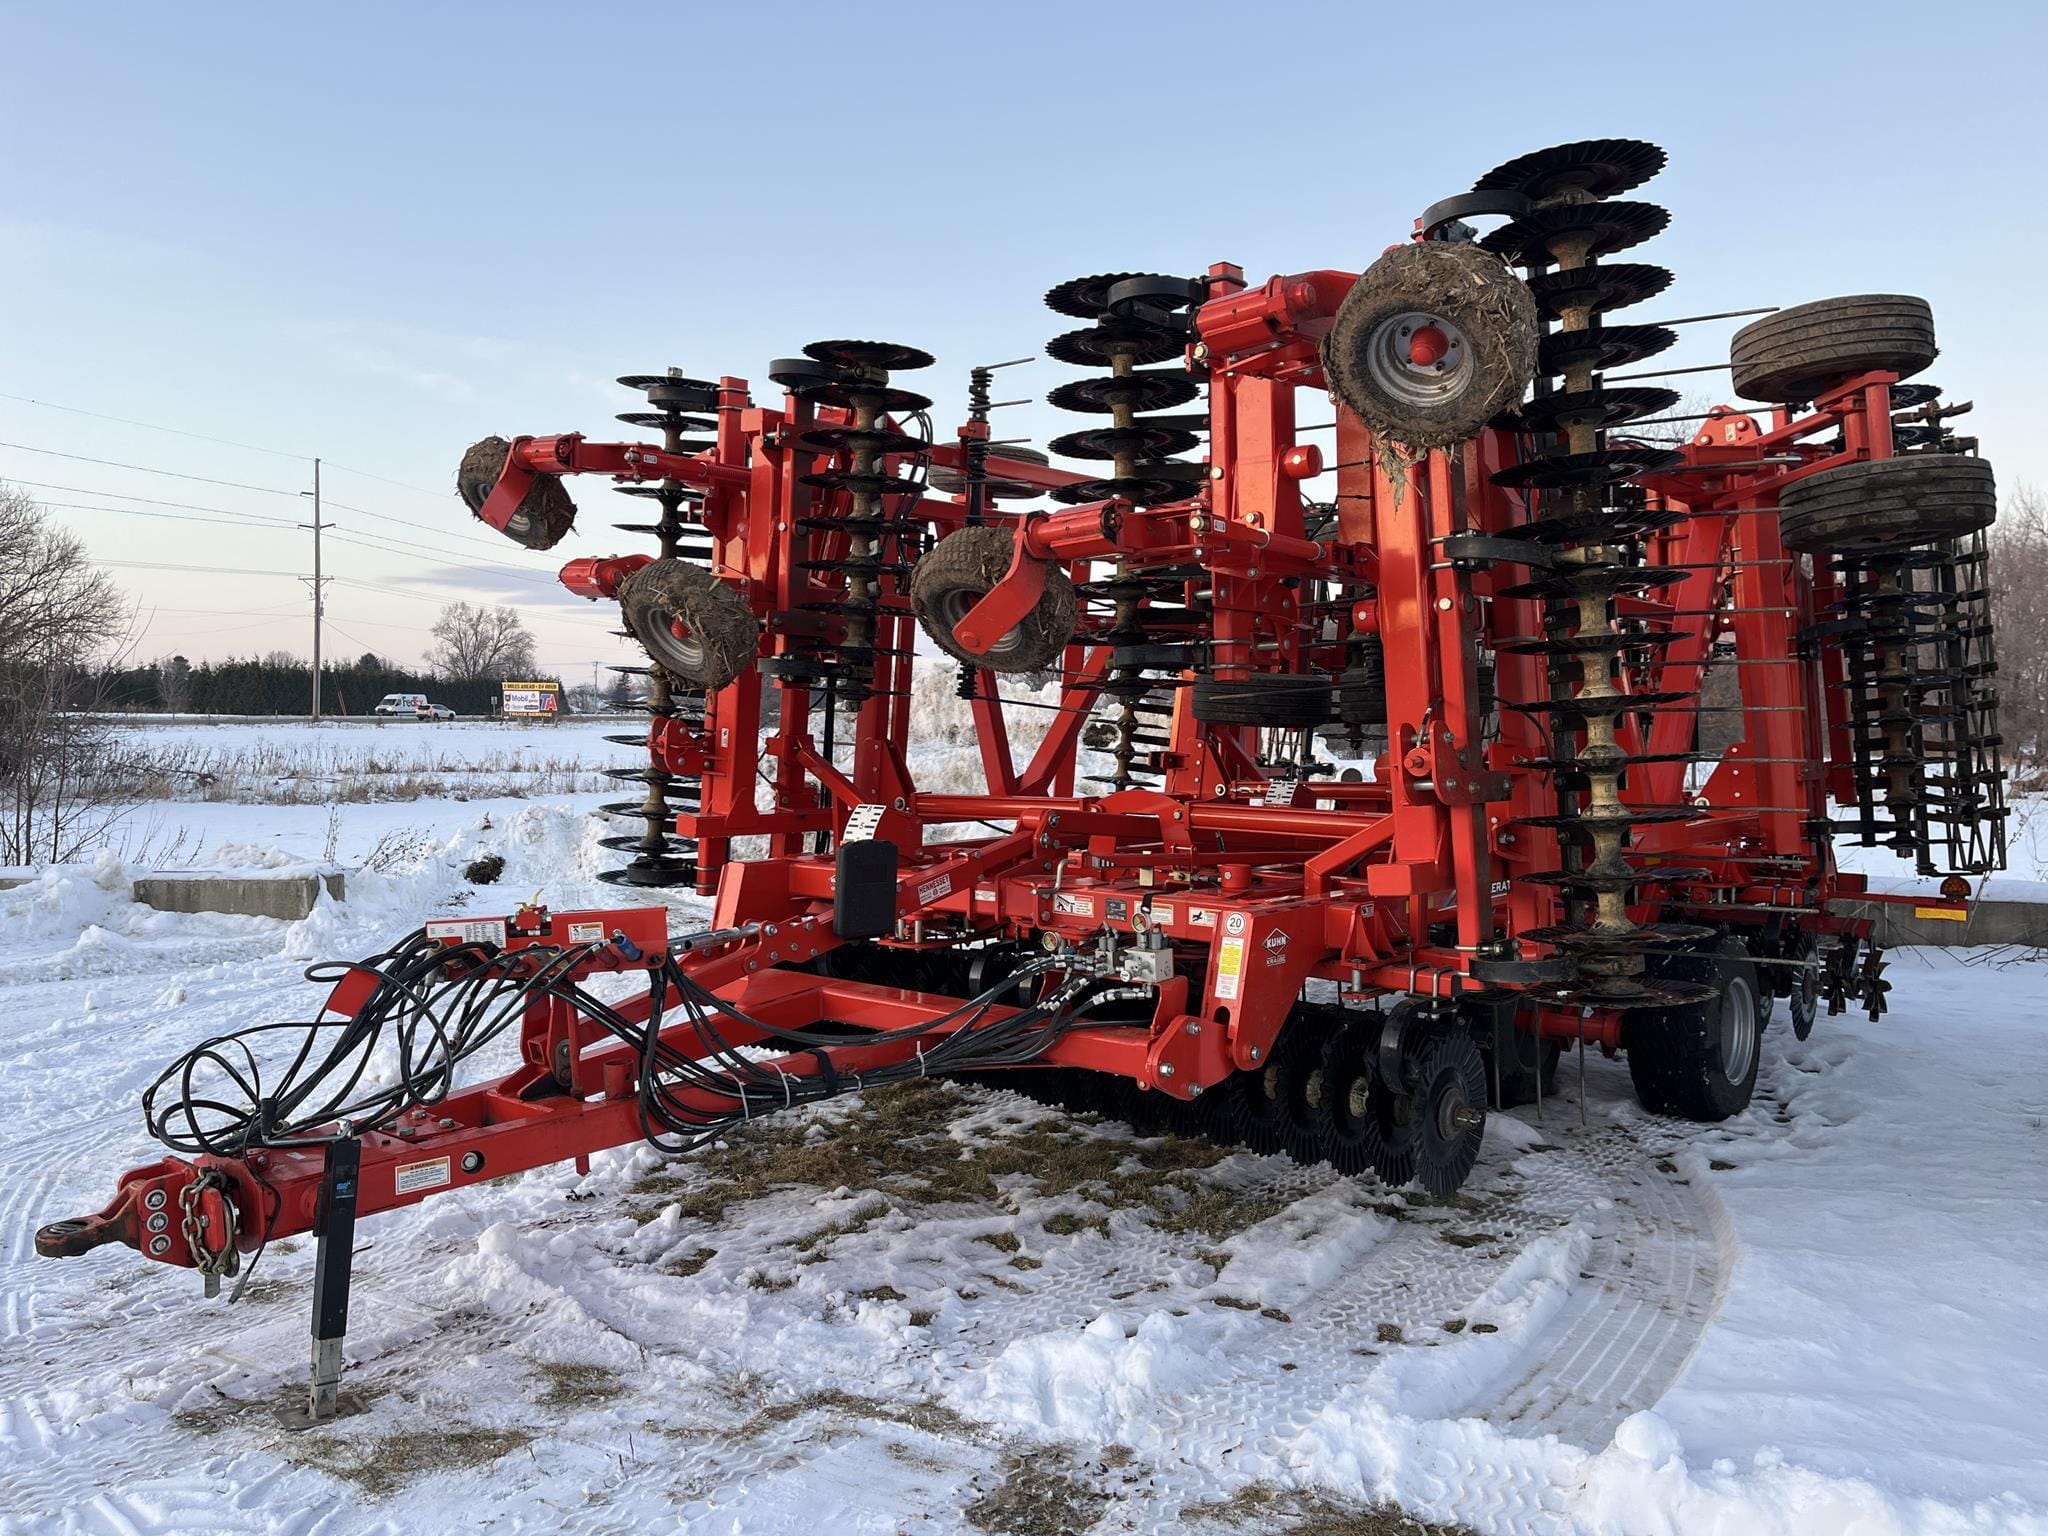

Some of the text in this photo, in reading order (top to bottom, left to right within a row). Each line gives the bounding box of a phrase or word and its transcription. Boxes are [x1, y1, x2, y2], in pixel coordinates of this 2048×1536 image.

[402, 696, 423, 707] FedEx
[512, 694, 528, 702] Mobil
[540, 694, 558, 711] TA
[919, 876, 949, 894] HENNESSEY
[1229, 917, 1242, 928] 20
[1267, 935, 1287, 949] KUHN
